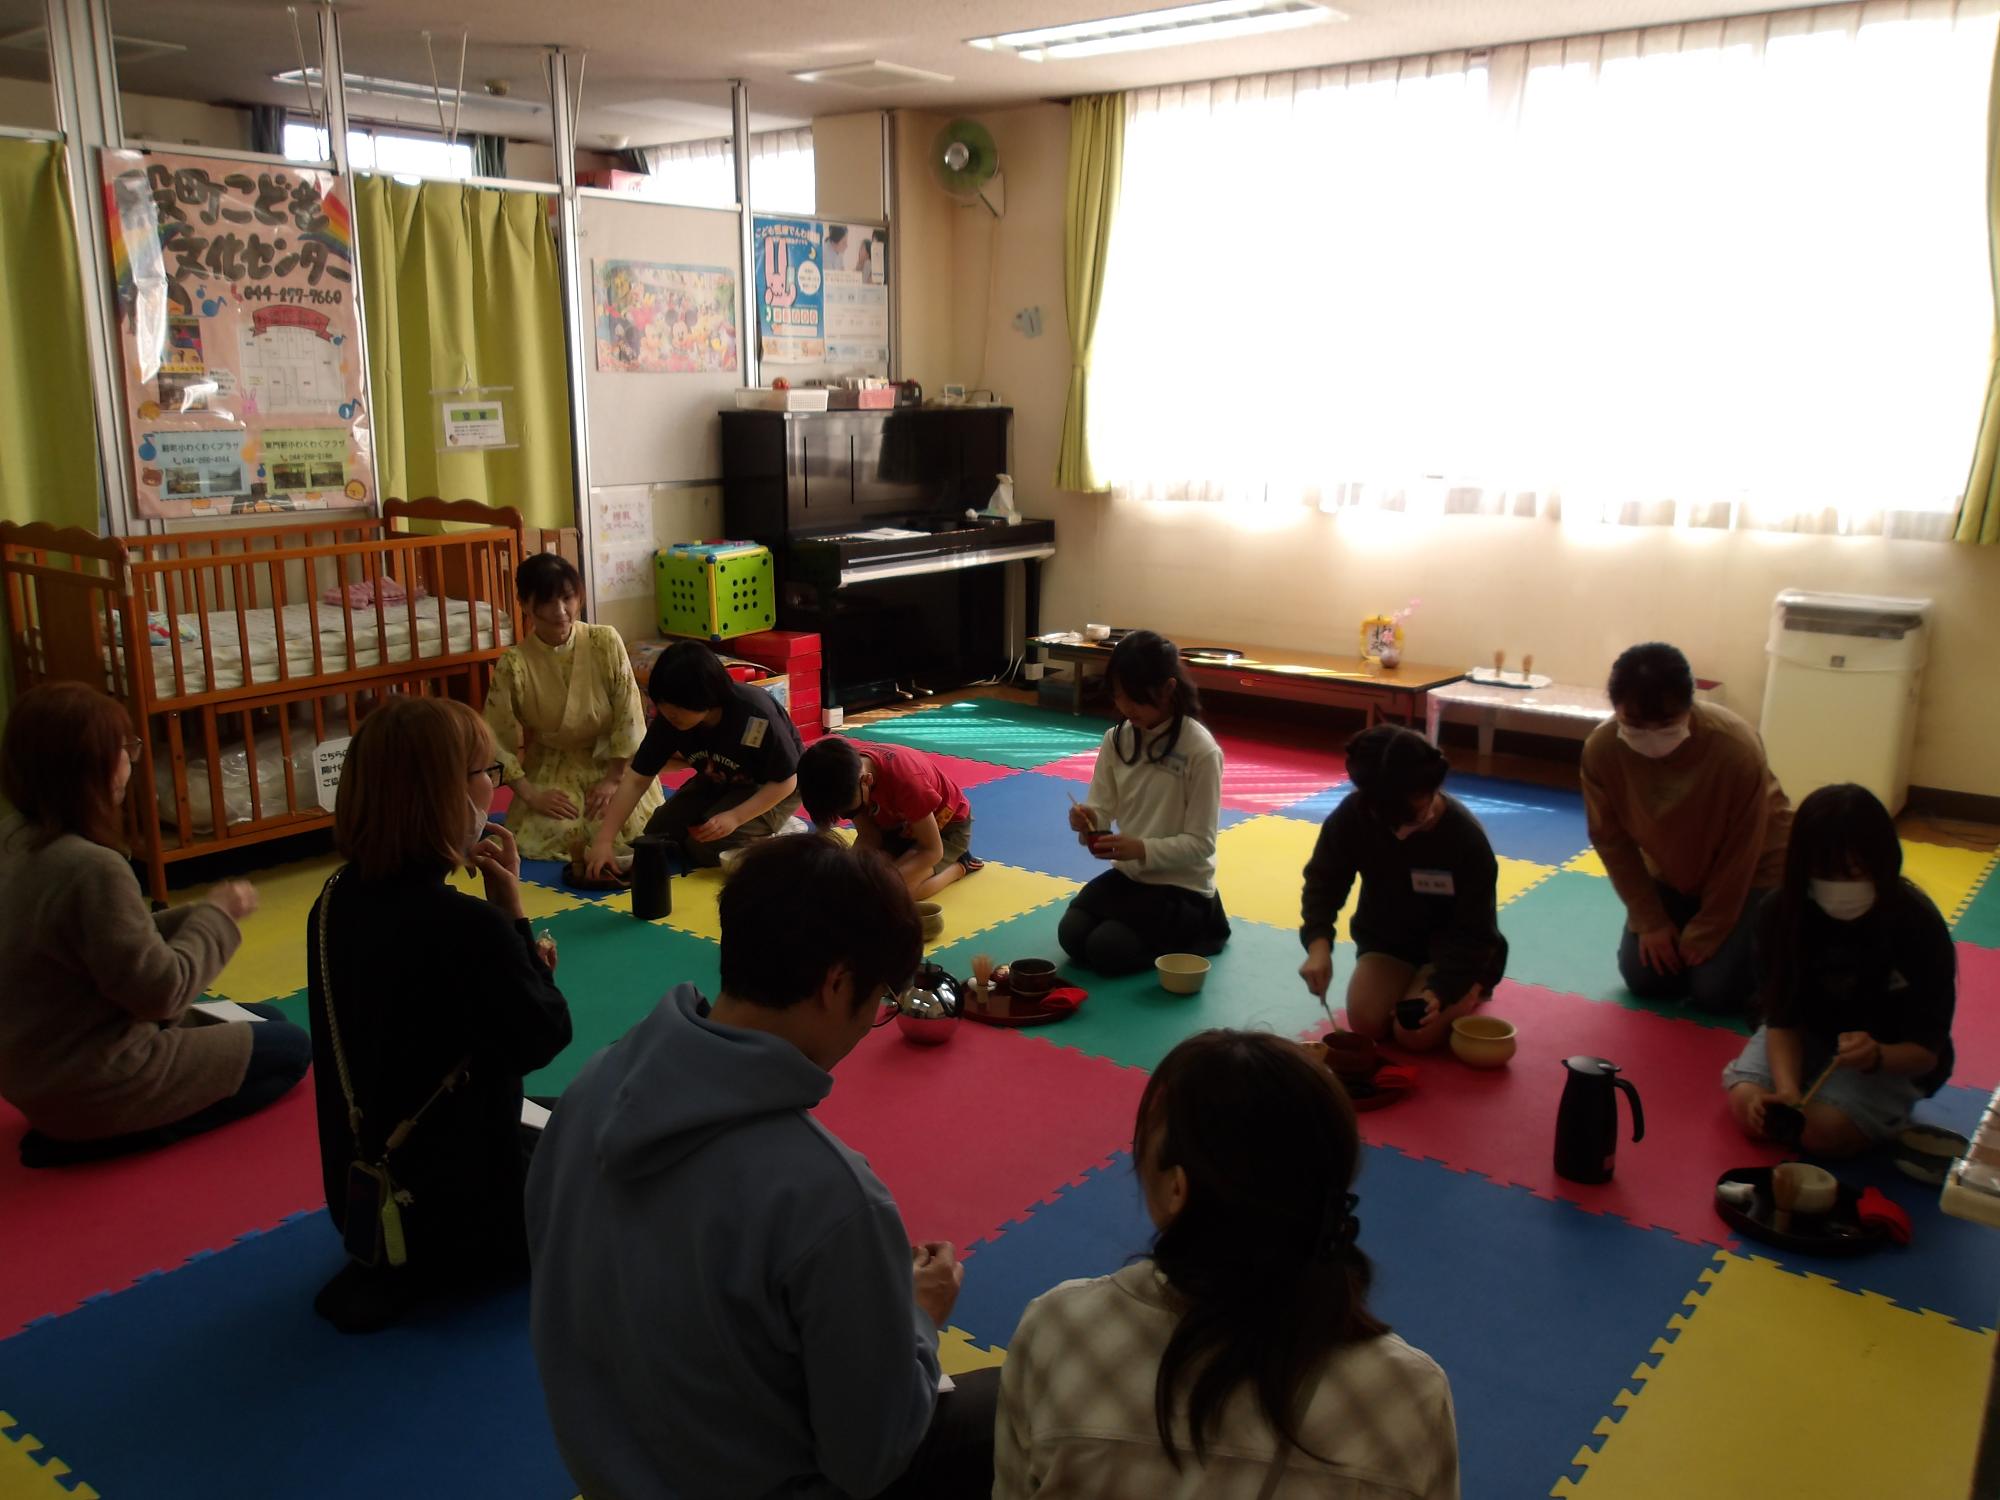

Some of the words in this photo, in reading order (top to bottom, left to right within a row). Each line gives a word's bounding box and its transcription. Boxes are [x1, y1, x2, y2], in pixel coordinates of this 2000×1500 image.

[168, 224, 352, 286] 文化センター
[244, 285, 342, 304] 044-277-7660
